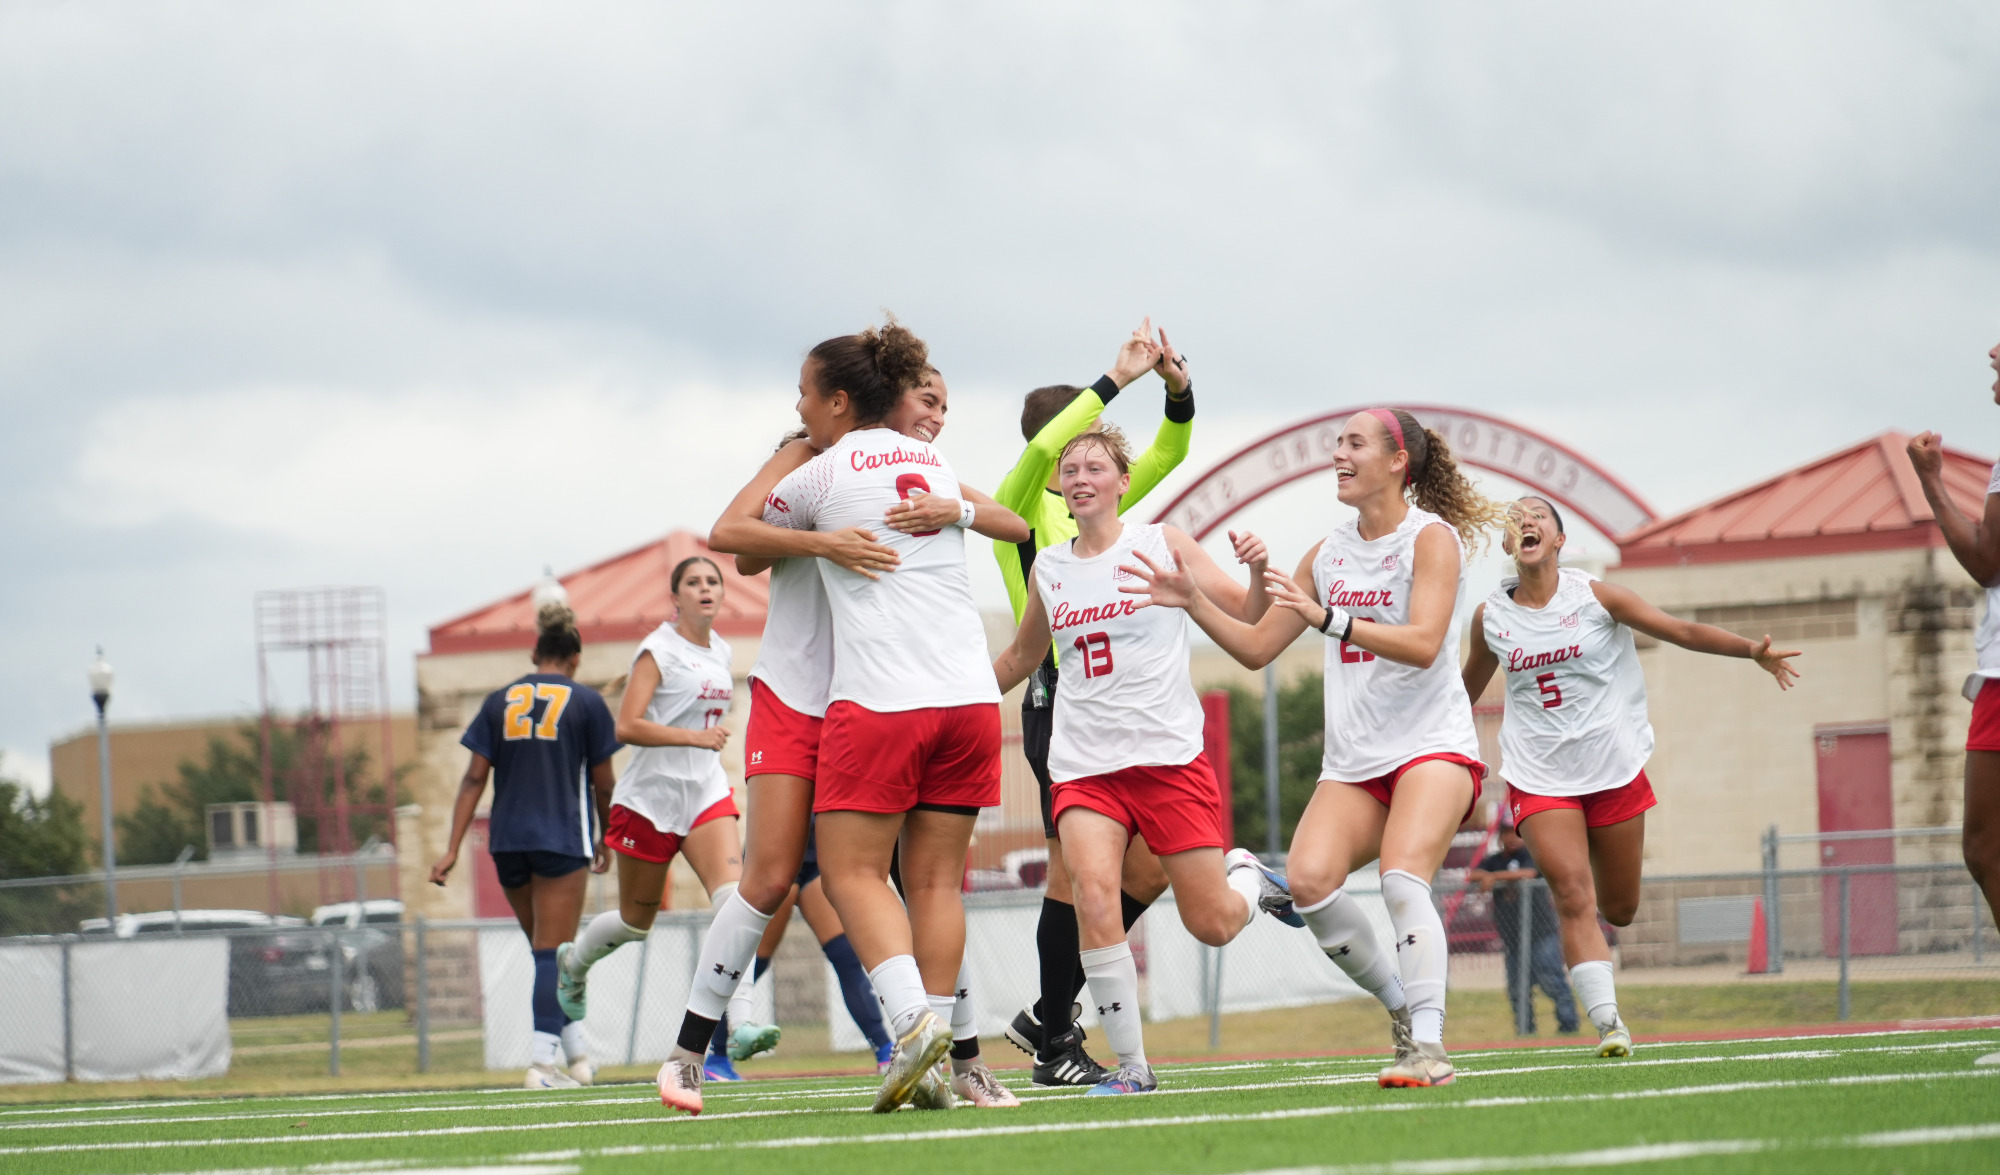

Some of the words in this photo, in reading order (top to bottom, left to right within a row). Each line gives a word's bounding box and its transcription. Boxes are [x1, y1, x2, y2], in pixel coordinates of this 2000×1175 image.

[850, 446, 942, 471] Cardinals
[1328, 580, 1393, 607] Lamar
[1051, 599, 1136, 632] Lamar
[1073, 631, 1114, 679] 13
[1507, 644, 1583, 672] Lamar
[1536, 672, 1562, 709] 5
[504, 683, 571, 741] 27
